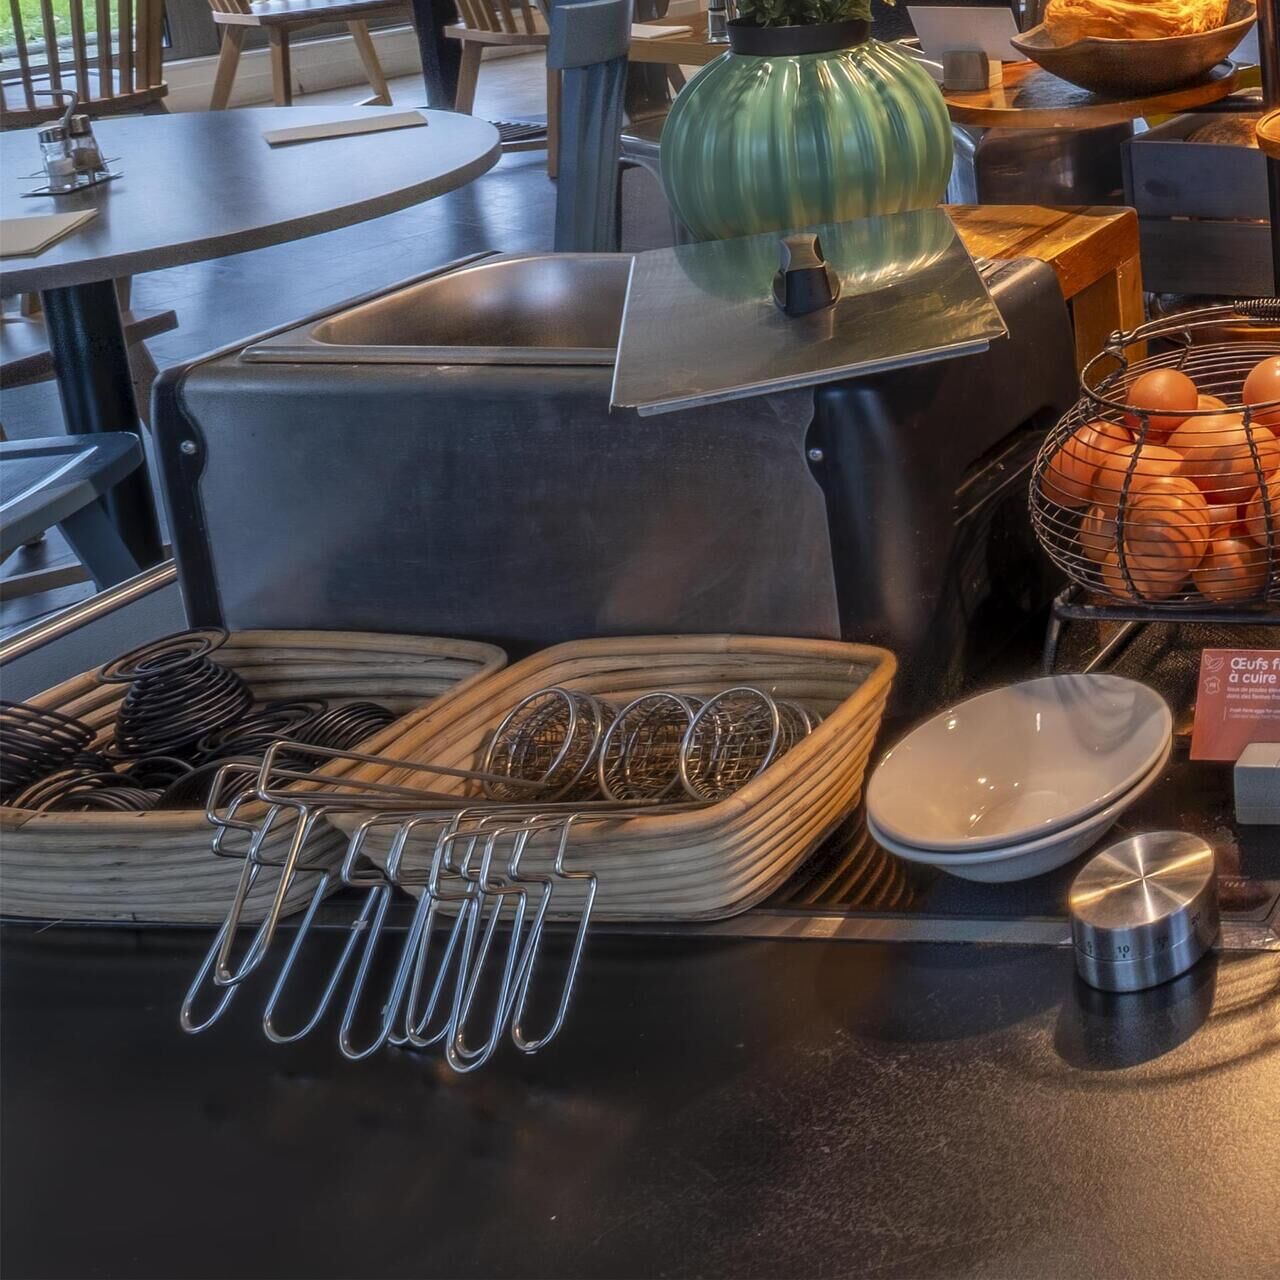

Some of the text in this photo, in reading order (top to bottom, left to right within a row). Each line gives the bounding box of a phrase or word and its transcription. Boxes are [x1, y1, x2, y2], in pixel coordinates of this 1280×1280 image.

[1231, 657, 1268, 670] Œufs
[1229, 671, 1277, 683] à cuire
[1118, 944, 1130, 954] 10
